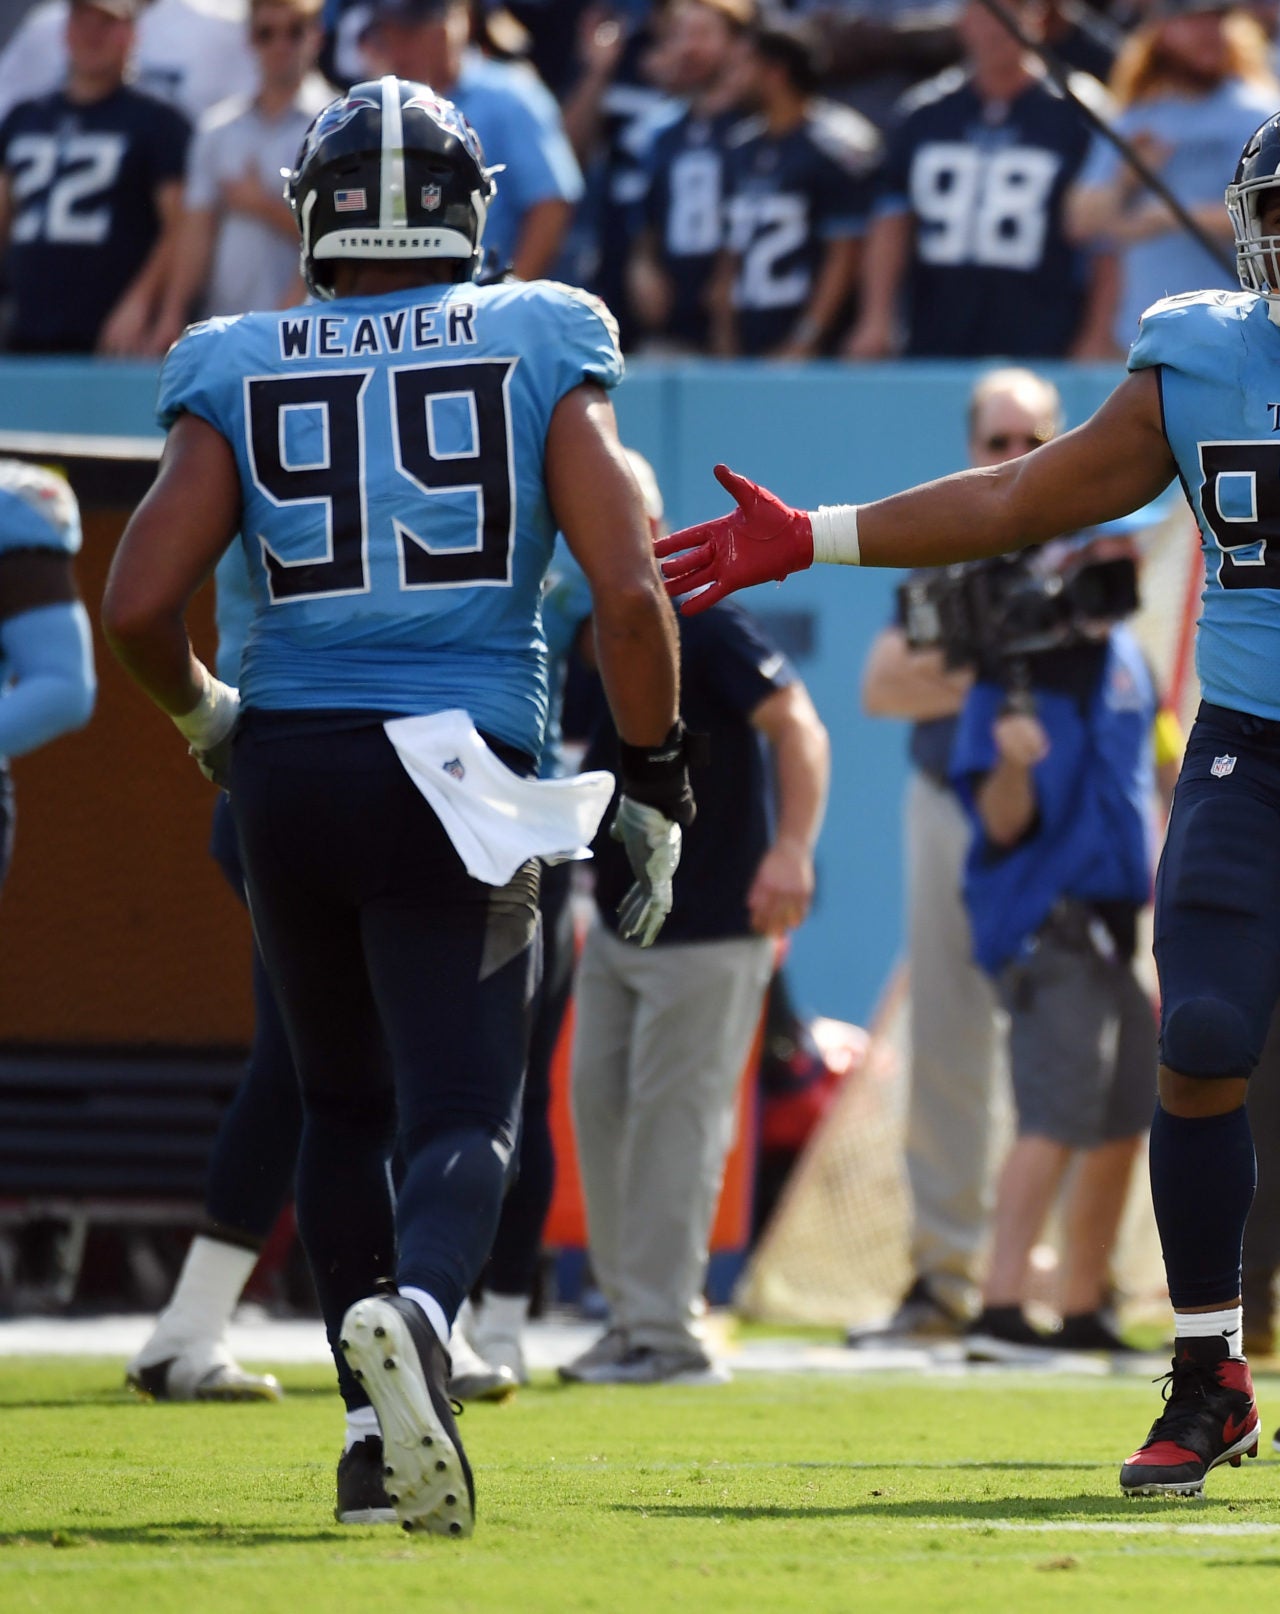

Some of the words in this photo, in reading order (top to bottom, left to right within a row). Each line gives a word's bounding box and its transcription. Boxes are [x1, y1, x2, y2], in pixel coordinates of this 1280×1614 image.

[339, 238, 442, 248] TENNESSEE
[910, 143, 1059, 270] 98
[279, 302, 478, 361] WEAVER
[243, 356, 520, 605] 99
